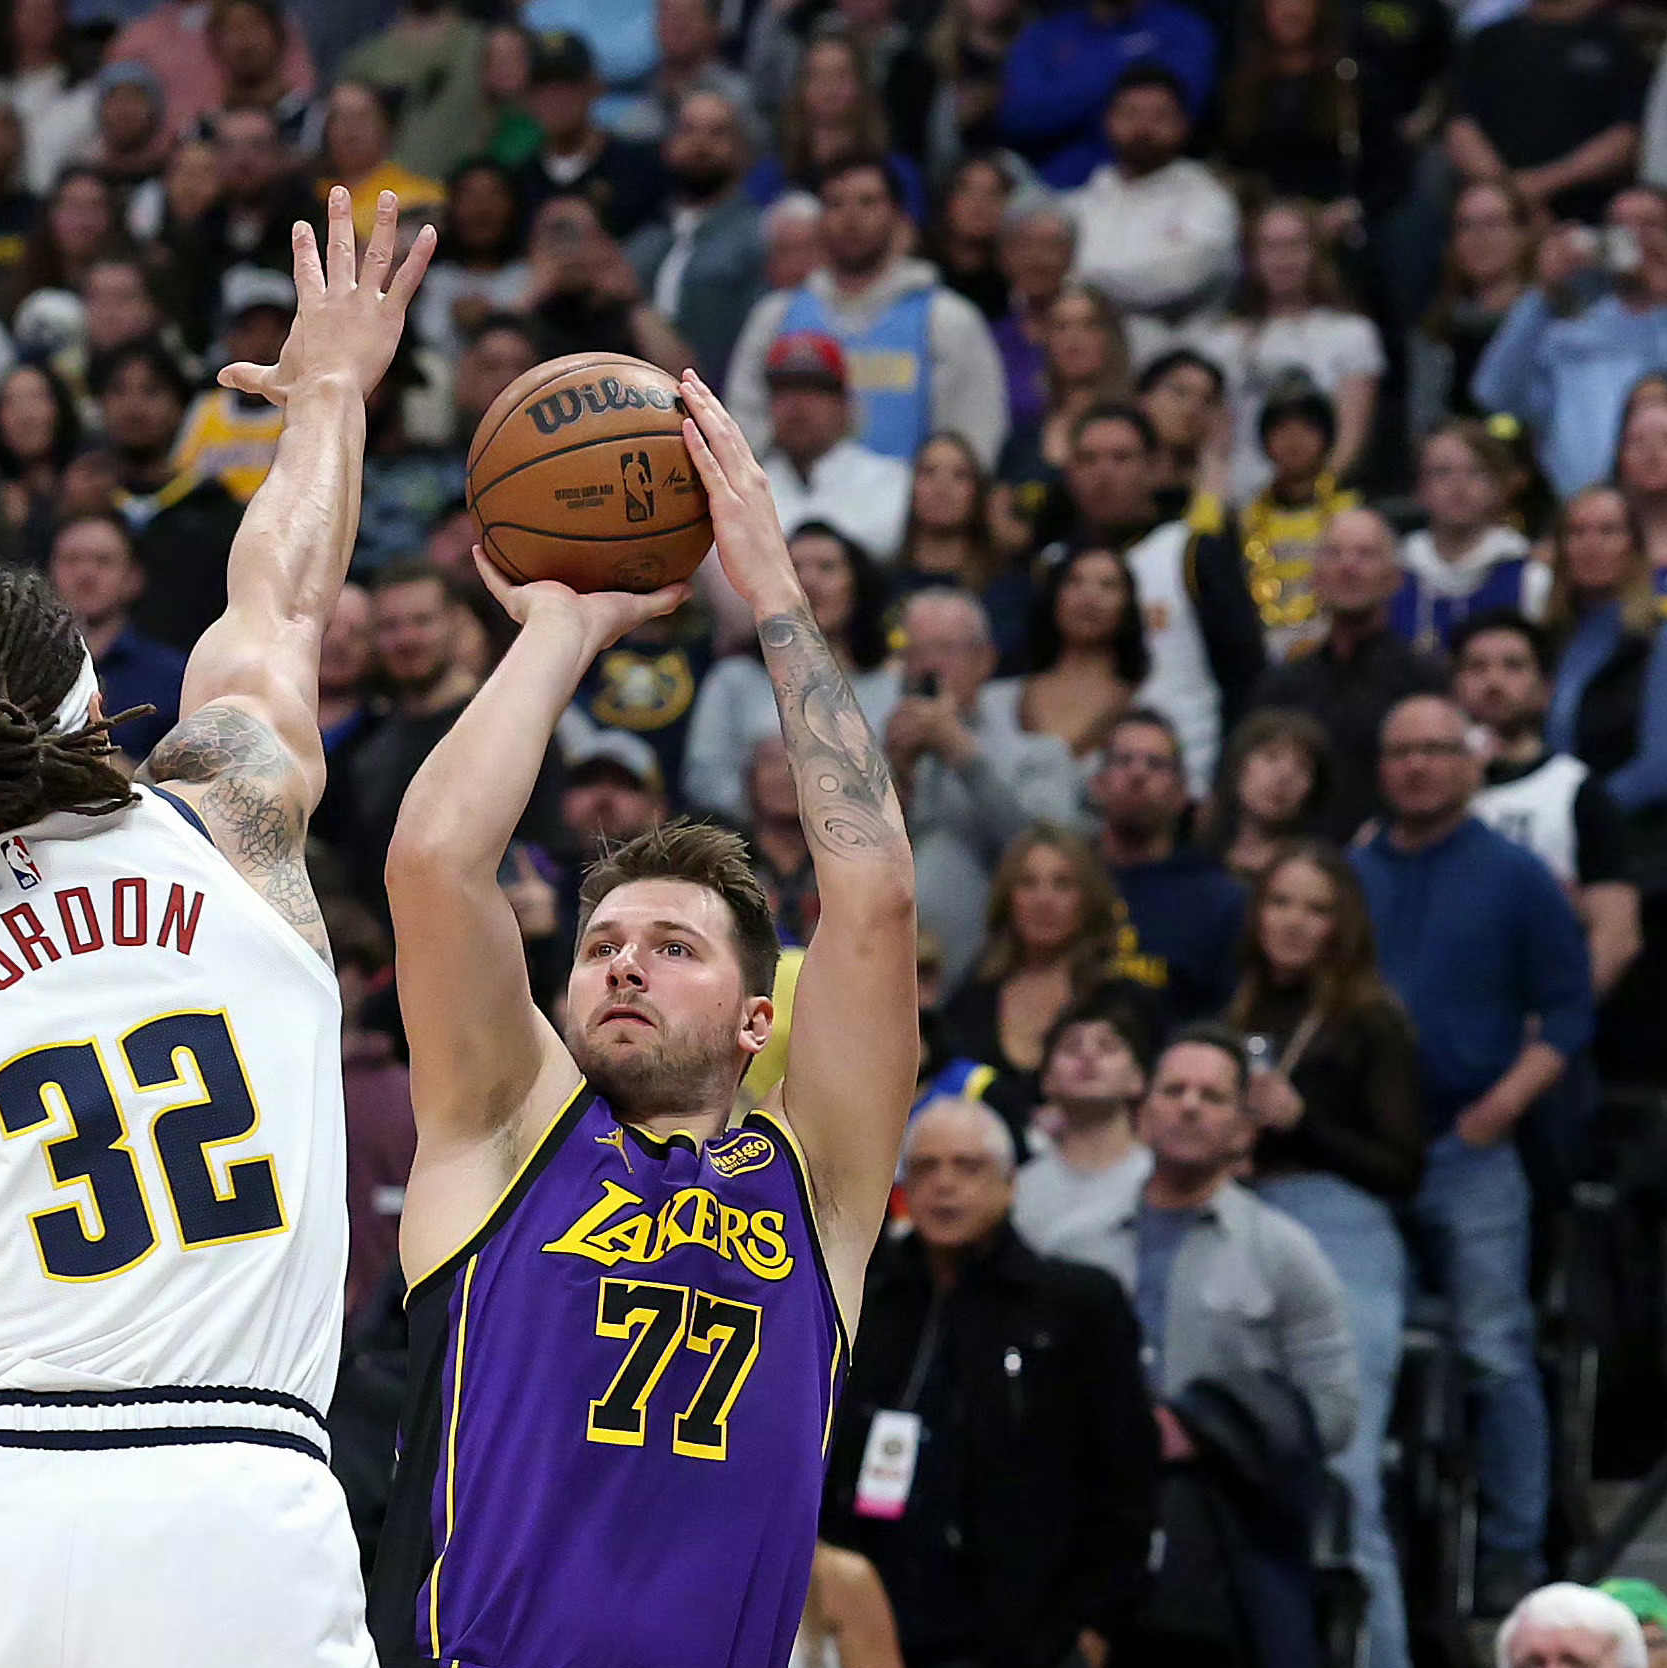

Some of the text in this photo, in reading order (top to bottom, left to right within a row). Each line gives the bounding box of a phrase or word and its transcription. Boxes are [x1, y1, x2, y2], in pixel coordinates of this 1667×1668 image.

[525, 376, 689, 434] Wilso
[542, 1178, 794, 1281] LAKERS
[586, 1276, 763, 1462] 77
